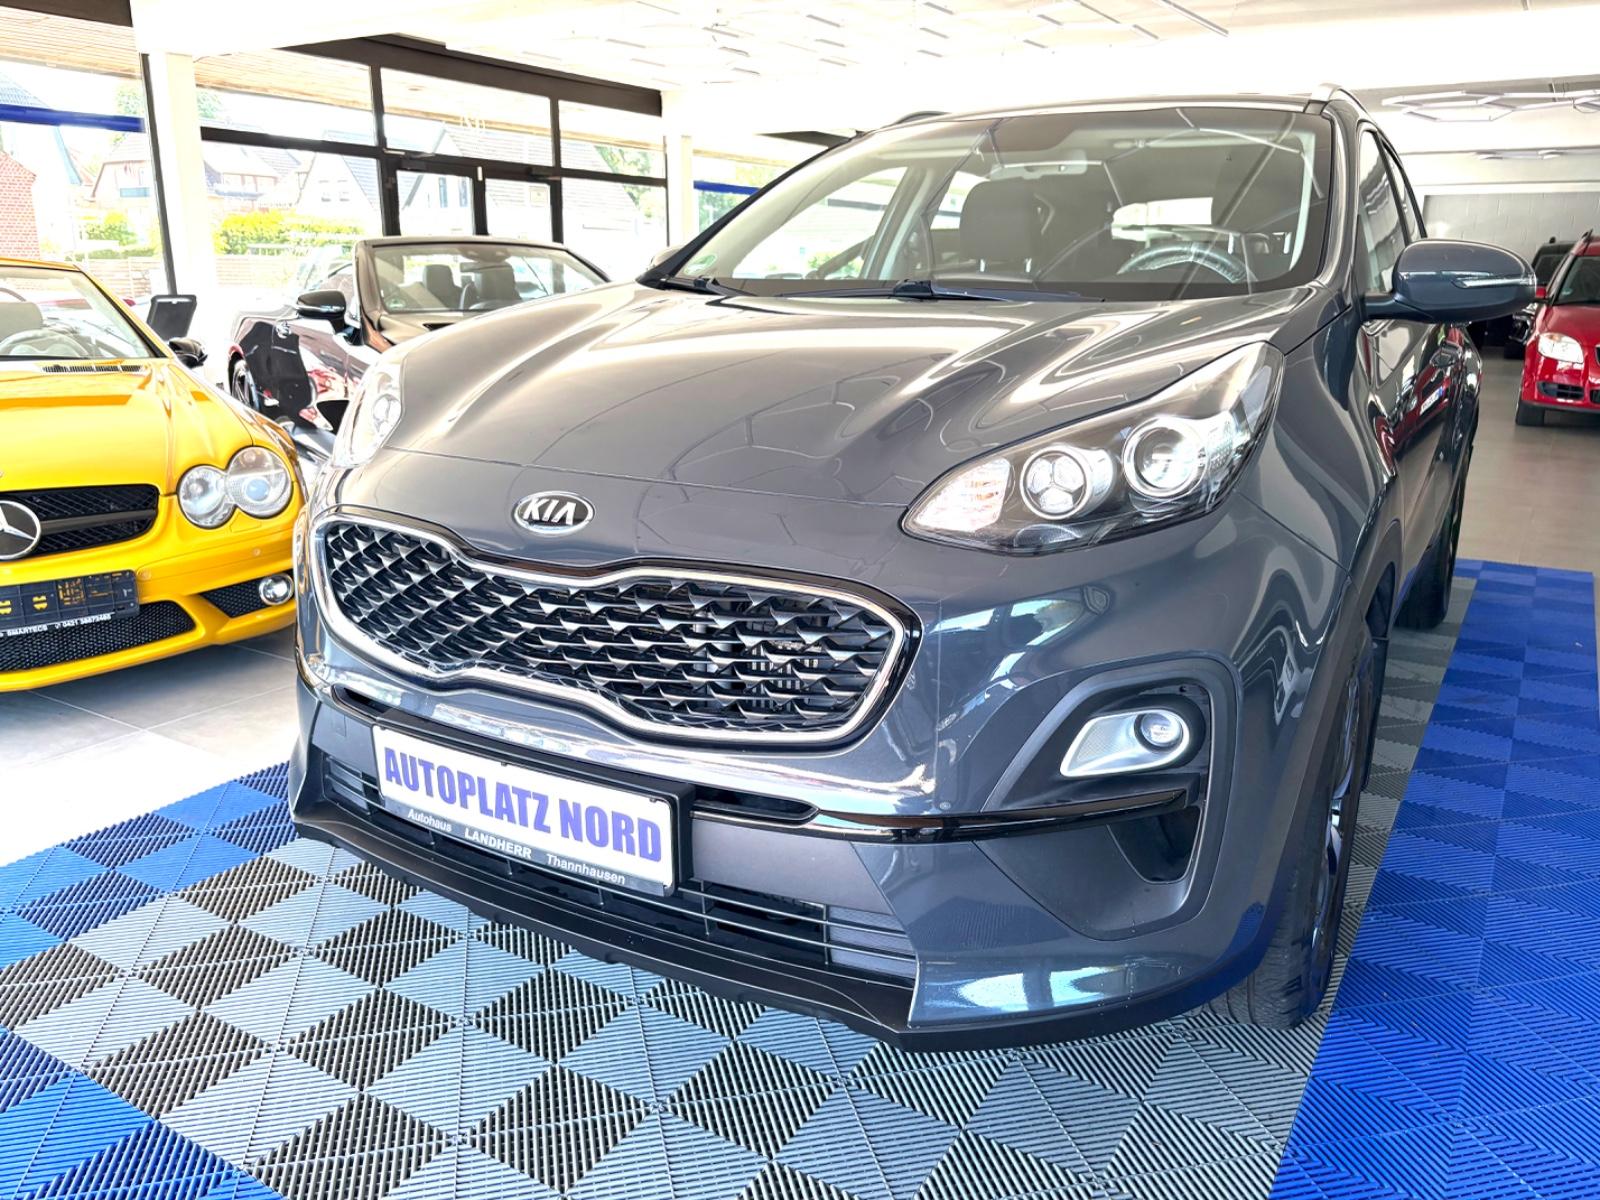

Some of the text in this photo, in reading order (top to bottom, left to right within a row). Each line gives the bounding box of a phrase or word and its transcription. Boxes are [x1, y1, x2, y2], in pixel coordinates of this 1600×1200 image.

[522, 498, 577, 525] KIA
[384, 746, 661, 862] AUTOPLATZ NORD
[407, 808, 626, 885] Autohaus LANDHERR Thannhausen
